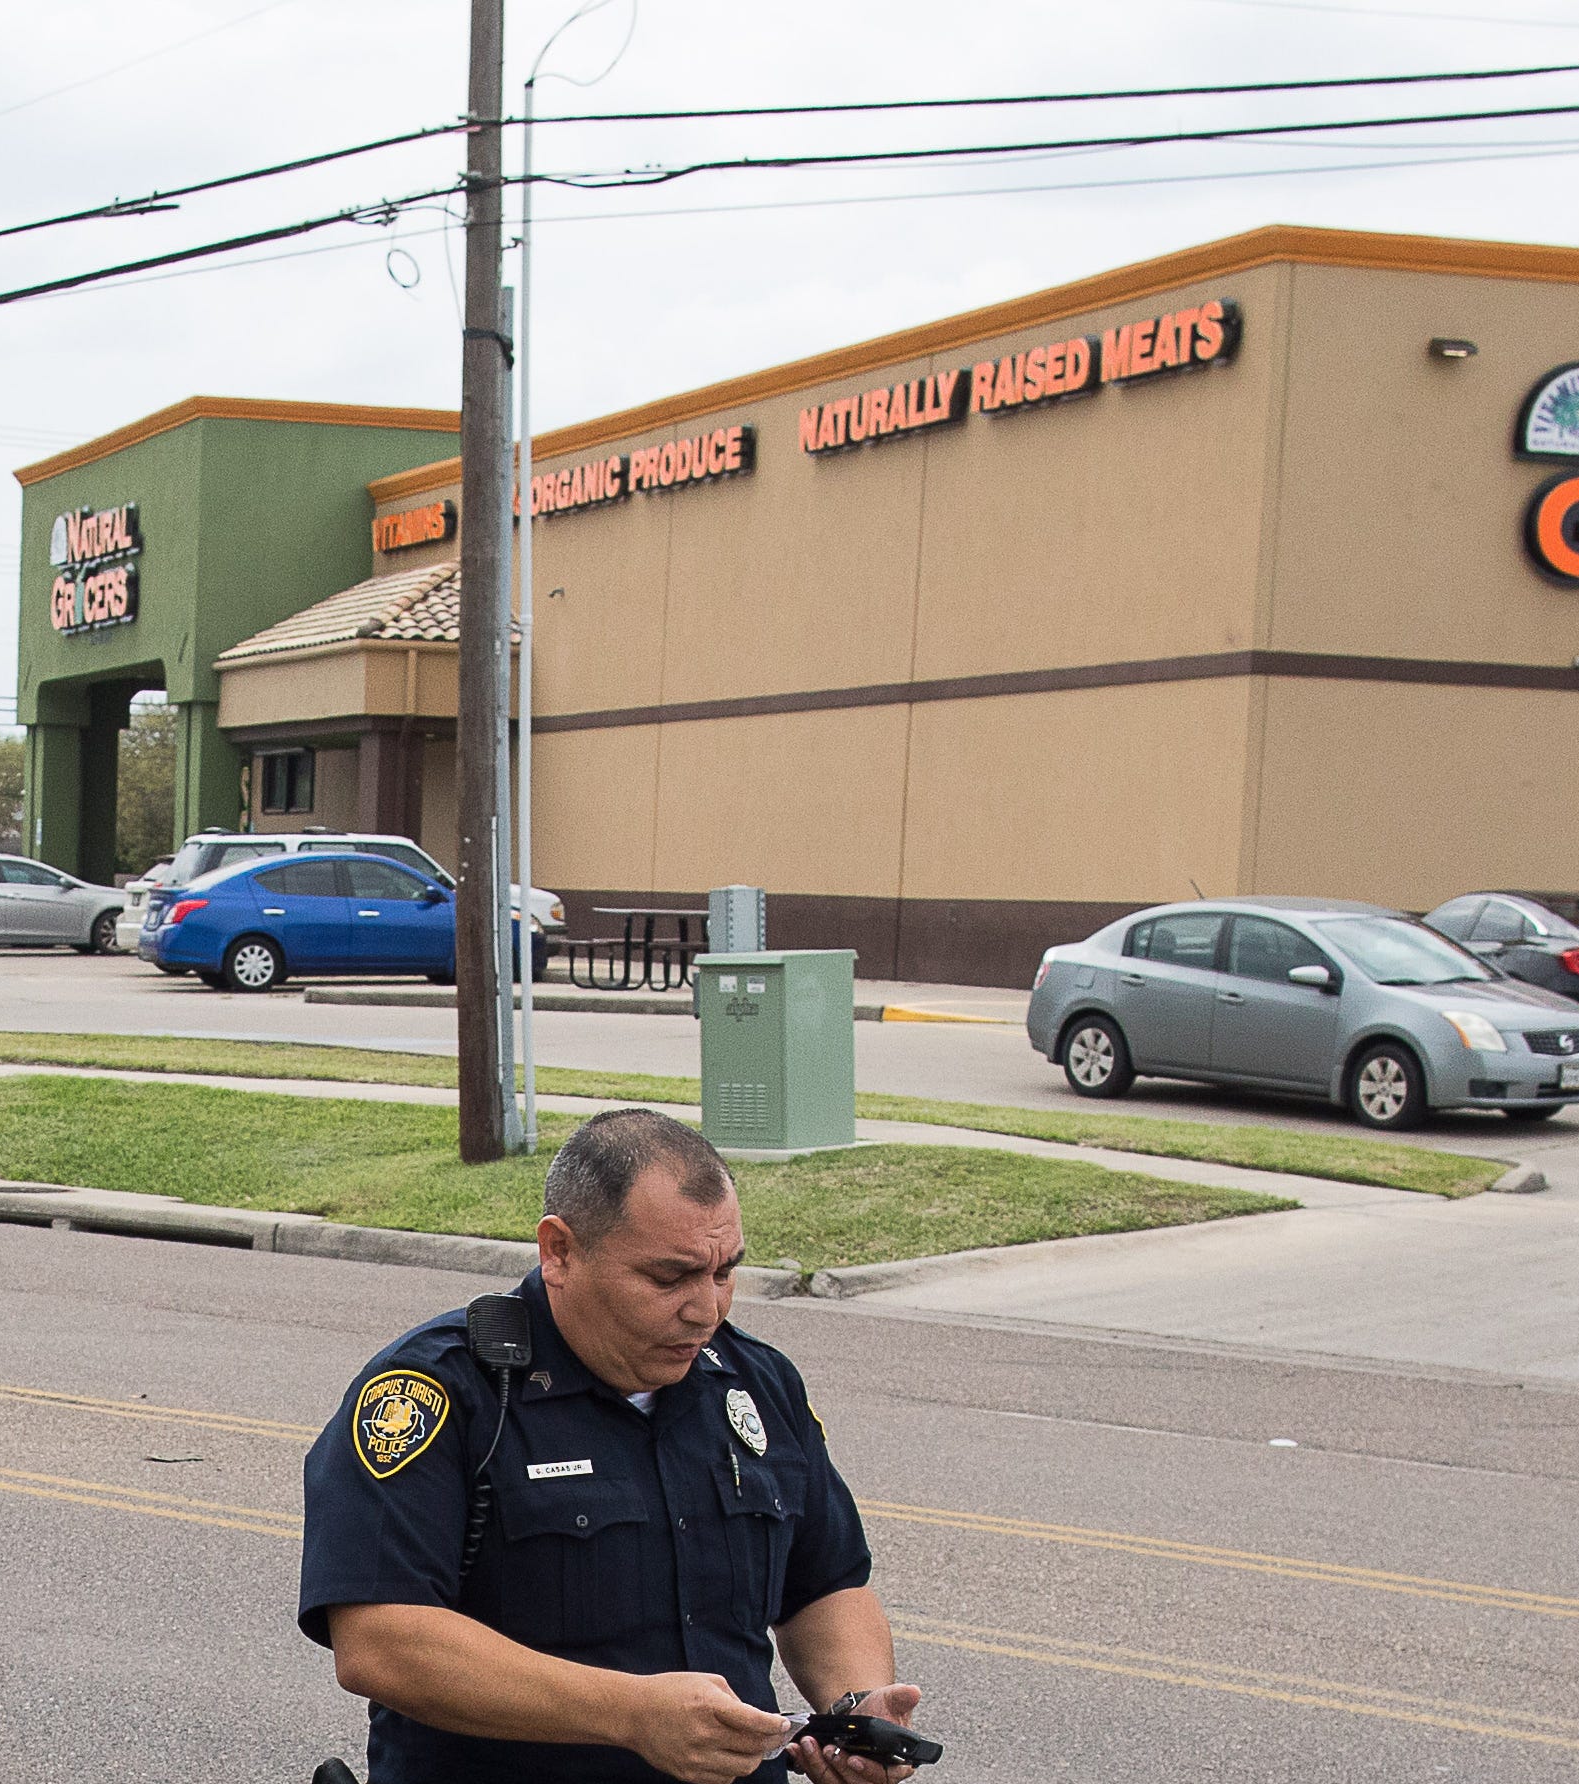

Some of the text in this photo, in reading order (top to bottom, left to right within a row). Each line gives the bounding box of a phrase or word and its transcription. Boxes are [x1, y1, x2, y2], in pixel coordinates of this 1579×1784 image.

[798, 300, 1224, 453] NATURALLY RAISED MEATS
[530, 455, 622, 516] ORGANIC
[628, 426, 743, 492] PRODUCE
[66, 506, 133, 564] NATURAL
[362, 1378, 443, 1417] CORPUS CHRISTI
[367, 1435, 409, 1454] POLICE
